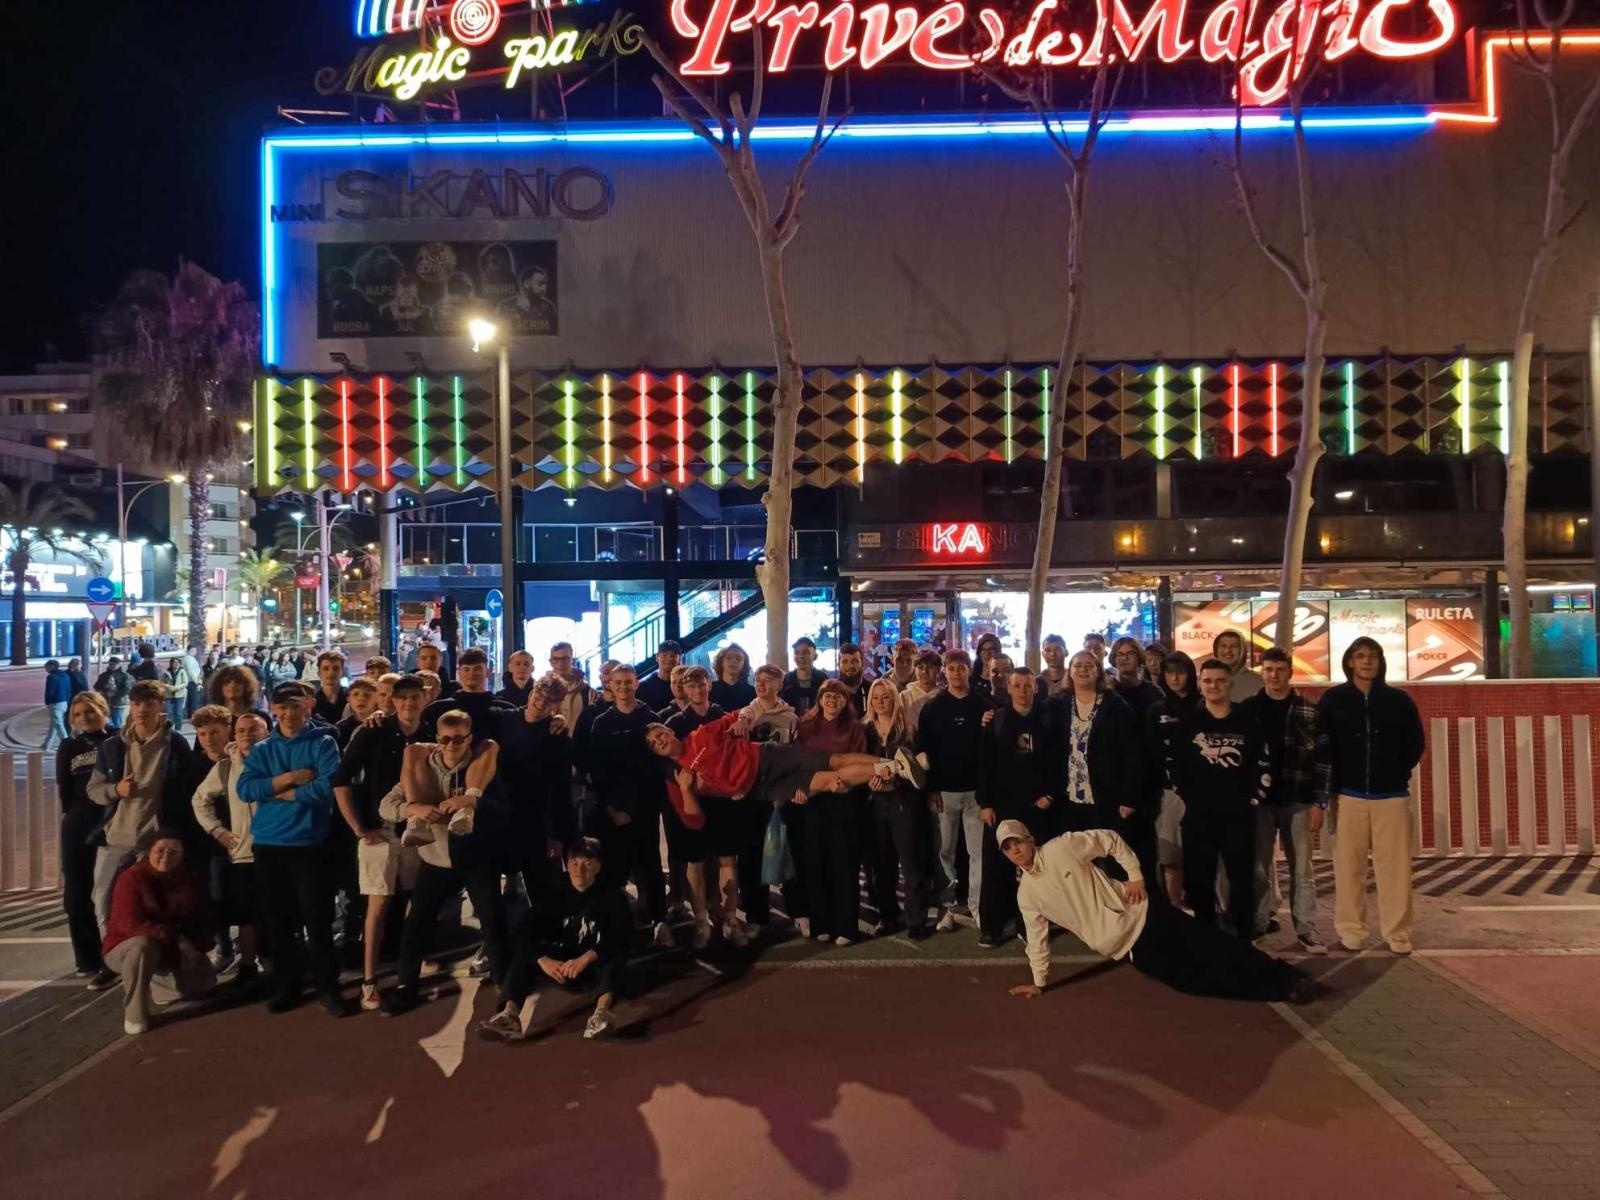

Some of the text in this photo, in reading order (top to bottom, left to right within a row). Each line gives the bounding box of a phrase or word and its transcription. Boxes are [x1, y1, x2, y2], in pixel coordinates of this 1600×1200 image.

[313, 35, 471, 100] Magic
[1003, 0, 1082, 66] de
[1078, 0, 1456, 106] Magic
[335, 167, 614, 221] SKANO
[1415, 607, 1474, 620] RULETA
[1417, 653, 1447, 661] POKER
